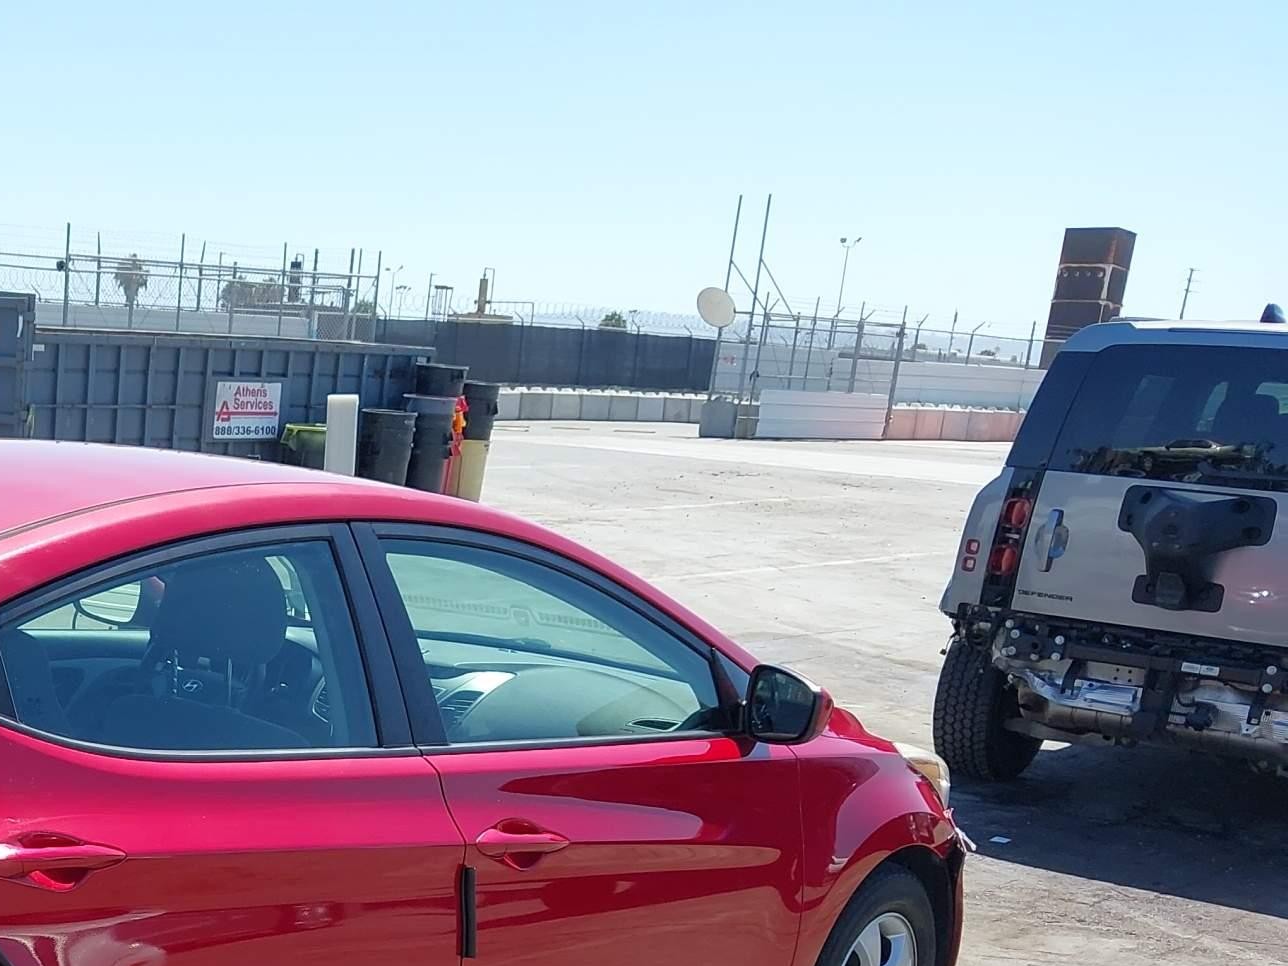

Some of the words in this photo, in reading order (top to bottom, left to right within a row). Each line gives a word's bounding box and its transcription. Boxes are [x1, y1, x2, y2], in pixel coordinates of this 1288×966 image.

[234, 385, 268, 397] Athens
[233, 397, 273, 410] Services
[215, 426, 276, 436] 888/336-6100
[1018, 589, 1072, 602] DEFENDER
